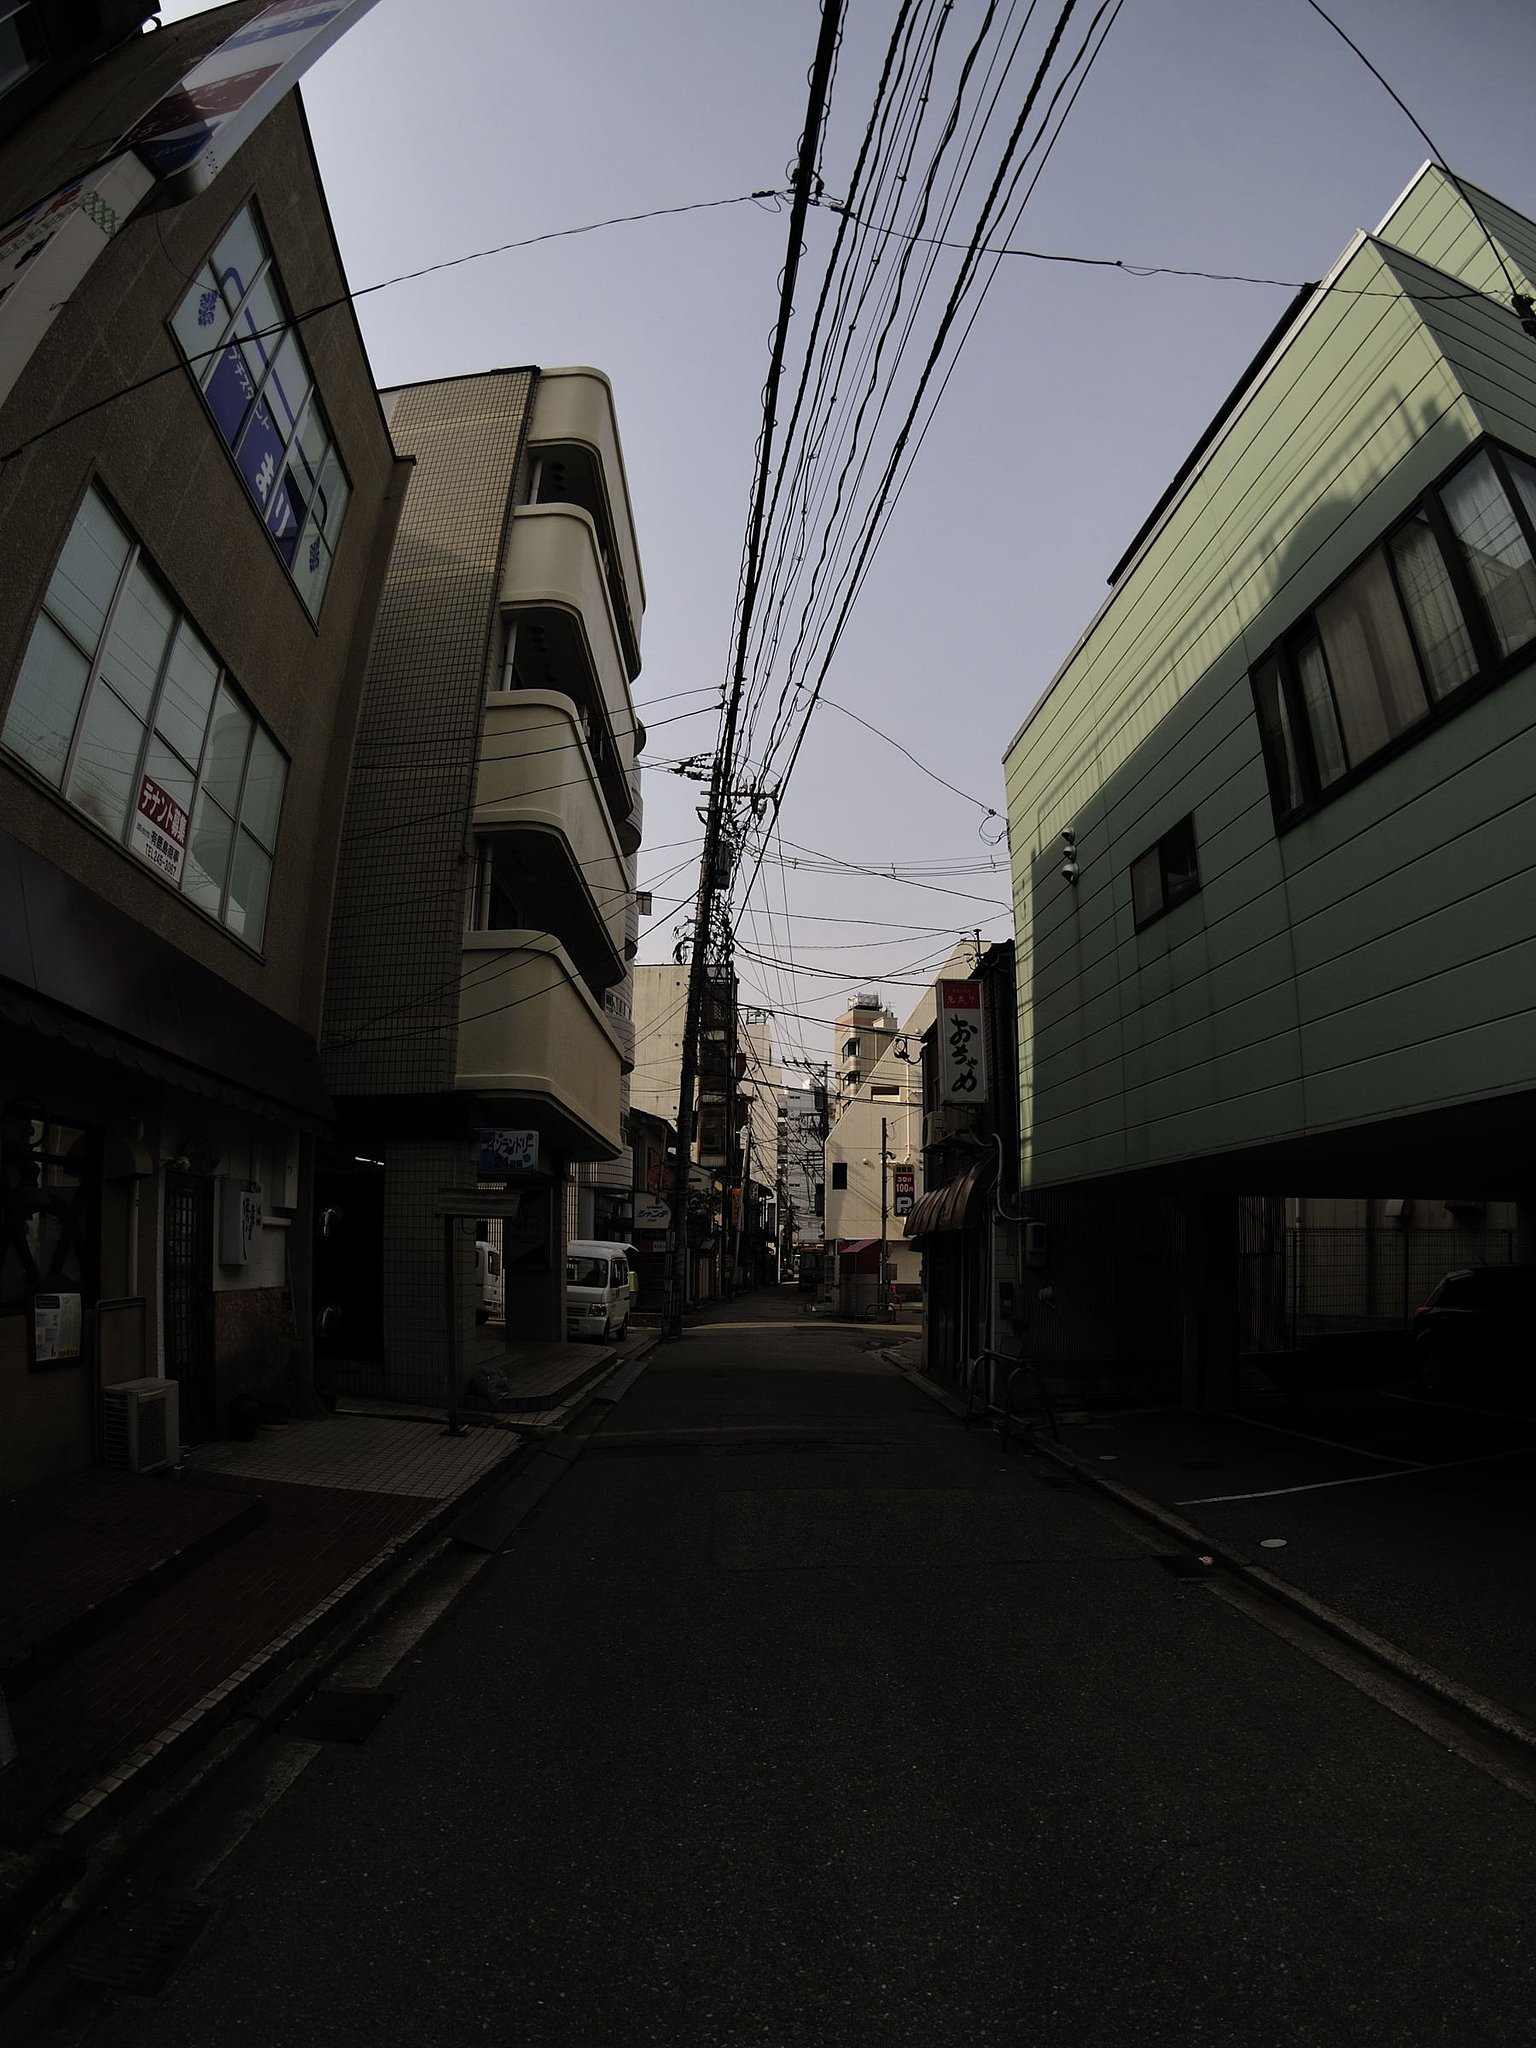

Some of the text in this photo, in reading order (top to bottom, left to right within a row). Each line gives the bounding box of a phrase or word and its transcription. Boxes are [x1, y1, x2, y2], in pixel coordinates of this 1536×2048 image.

[255, 451, 291, 538] まり
[949, 1013, 979, 1093] おちゃめ
[481, 1137, 534, 1154] コインランドリー
[895, 1183, 914, 1193] 100円
[639, 1209, 669, 1218] シャンテ
[896, 1196, 913, 1214] P
